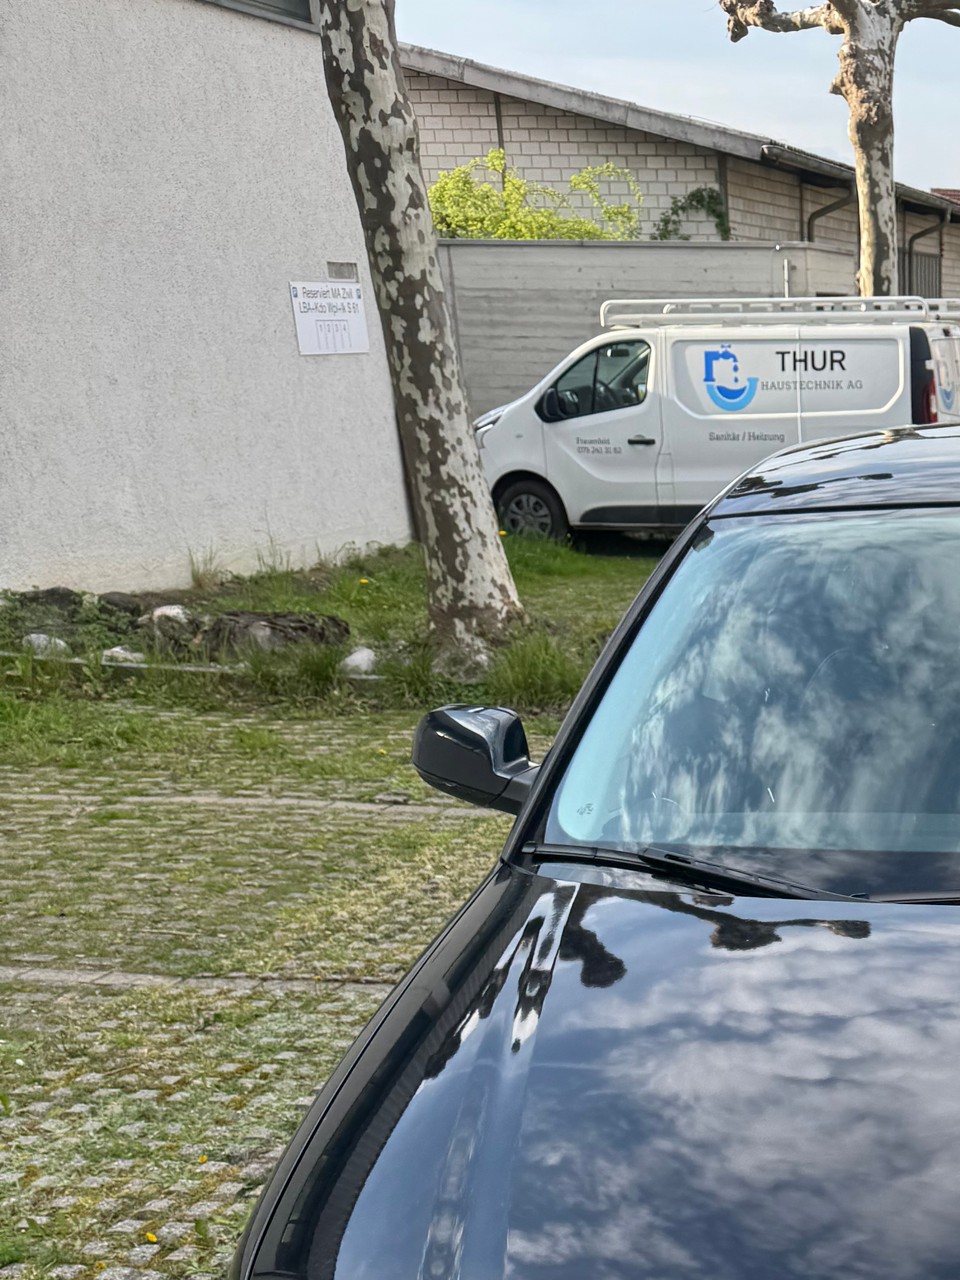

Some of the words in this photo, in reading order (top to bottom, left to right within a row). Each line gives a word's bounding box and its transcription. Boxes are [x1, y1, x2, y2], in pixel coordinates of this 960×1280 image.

[775, 350, 847, 372] THUR
[760, 380, 843, 391] HAUSTECHNIK
[846, 380, 863, 390] AG
[747, 431, 785, 443] Heizung
